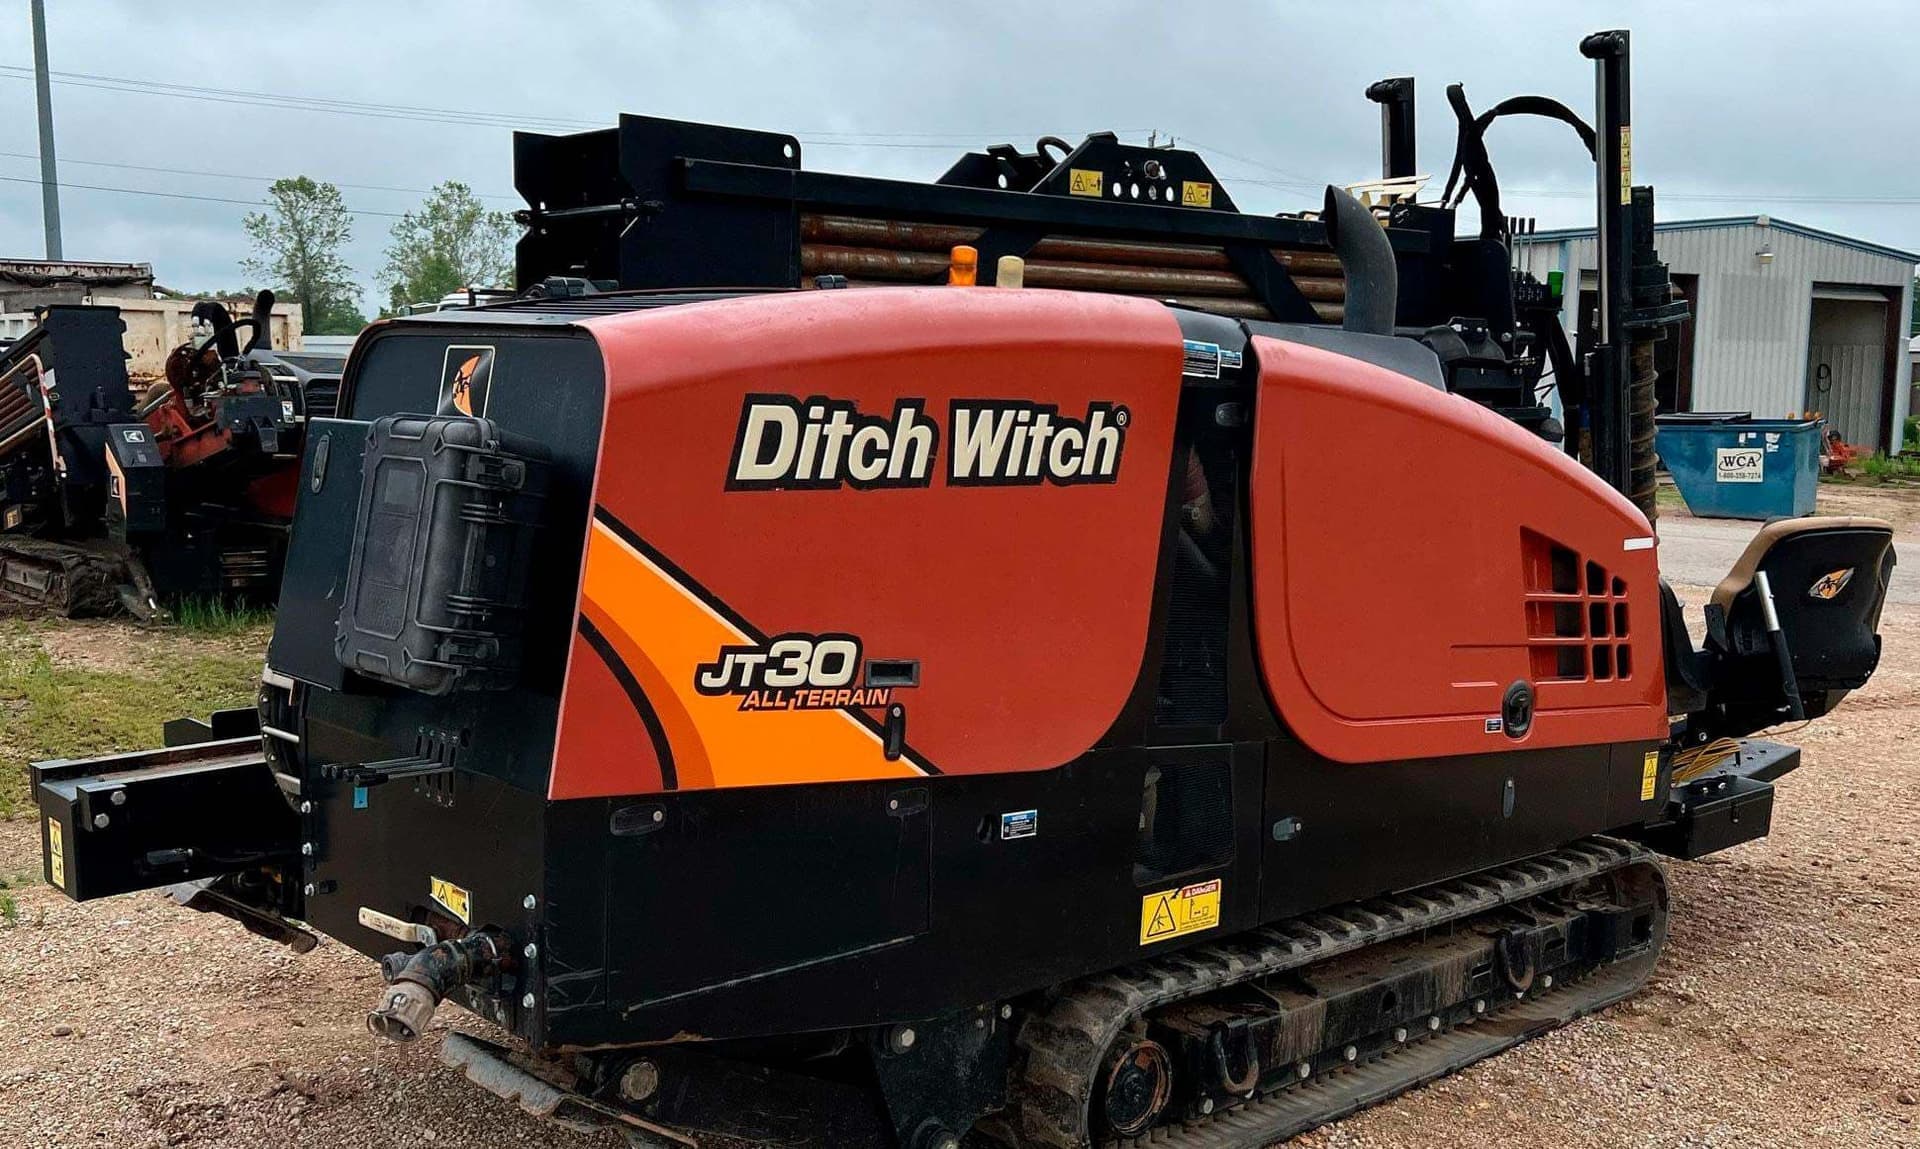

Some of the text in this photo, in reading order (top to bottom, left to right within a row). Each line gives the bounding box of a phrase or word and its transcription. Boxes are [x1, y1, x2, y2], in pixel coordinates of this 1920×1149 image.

[735, 404, 934, 481] Ditch
[1722, 455, 1758, 468] WCA
[700, 639, 858, 688] JT30
[742, 688, 890, 708] ALL TERRAIN
[1191, 882, 1218, 896] DANGER
